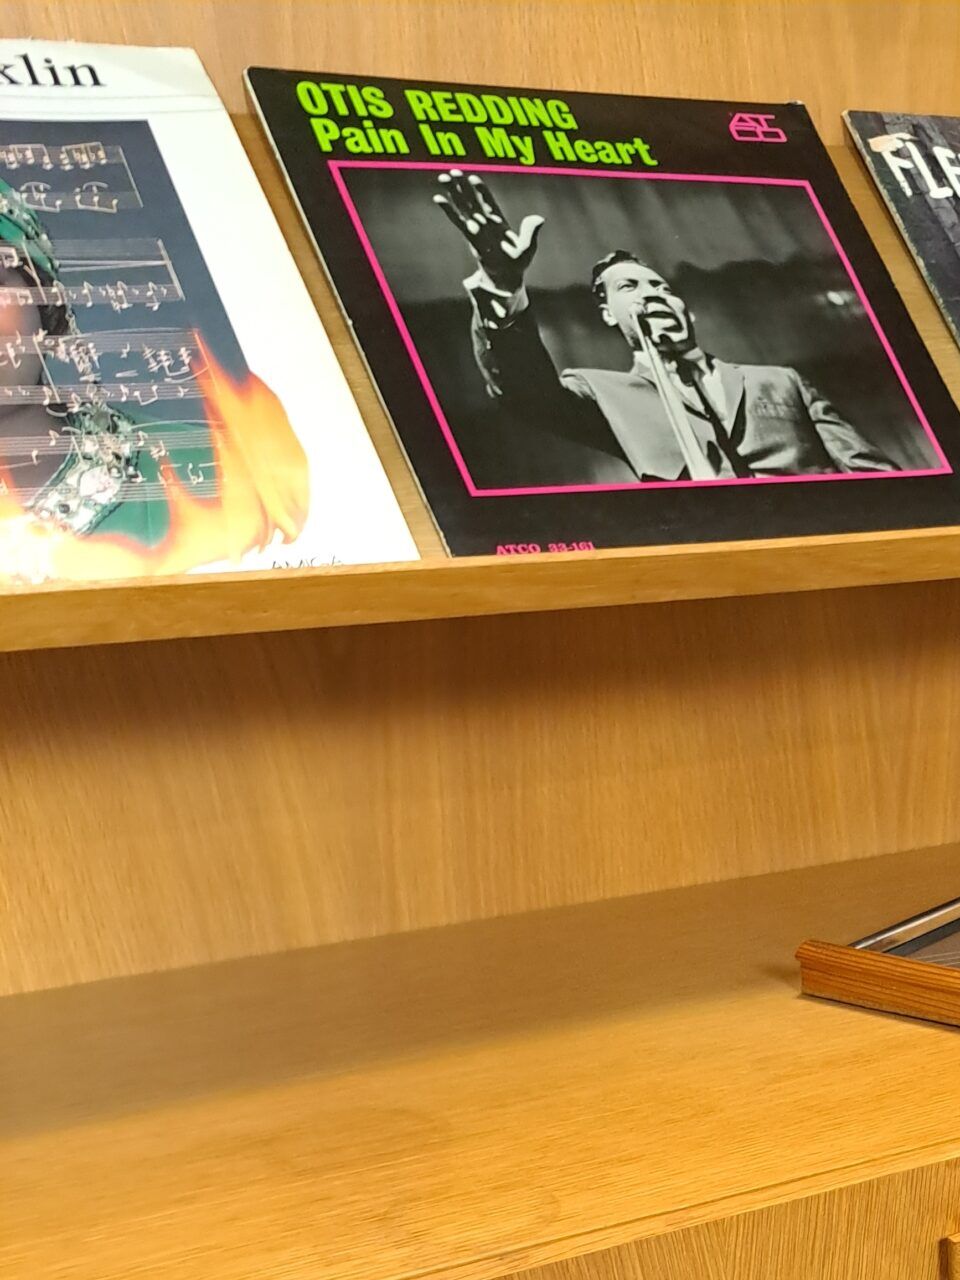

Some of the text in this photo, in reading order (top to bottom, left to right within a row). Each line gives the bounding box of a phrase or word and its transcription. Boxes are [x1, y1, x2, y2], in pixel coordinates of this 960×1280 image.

[296, 81, 578, 130] OTIS REDDING
[310, 117, 658, 166] Pain In My Heart
[497, 543, 541, 555] ATCO
